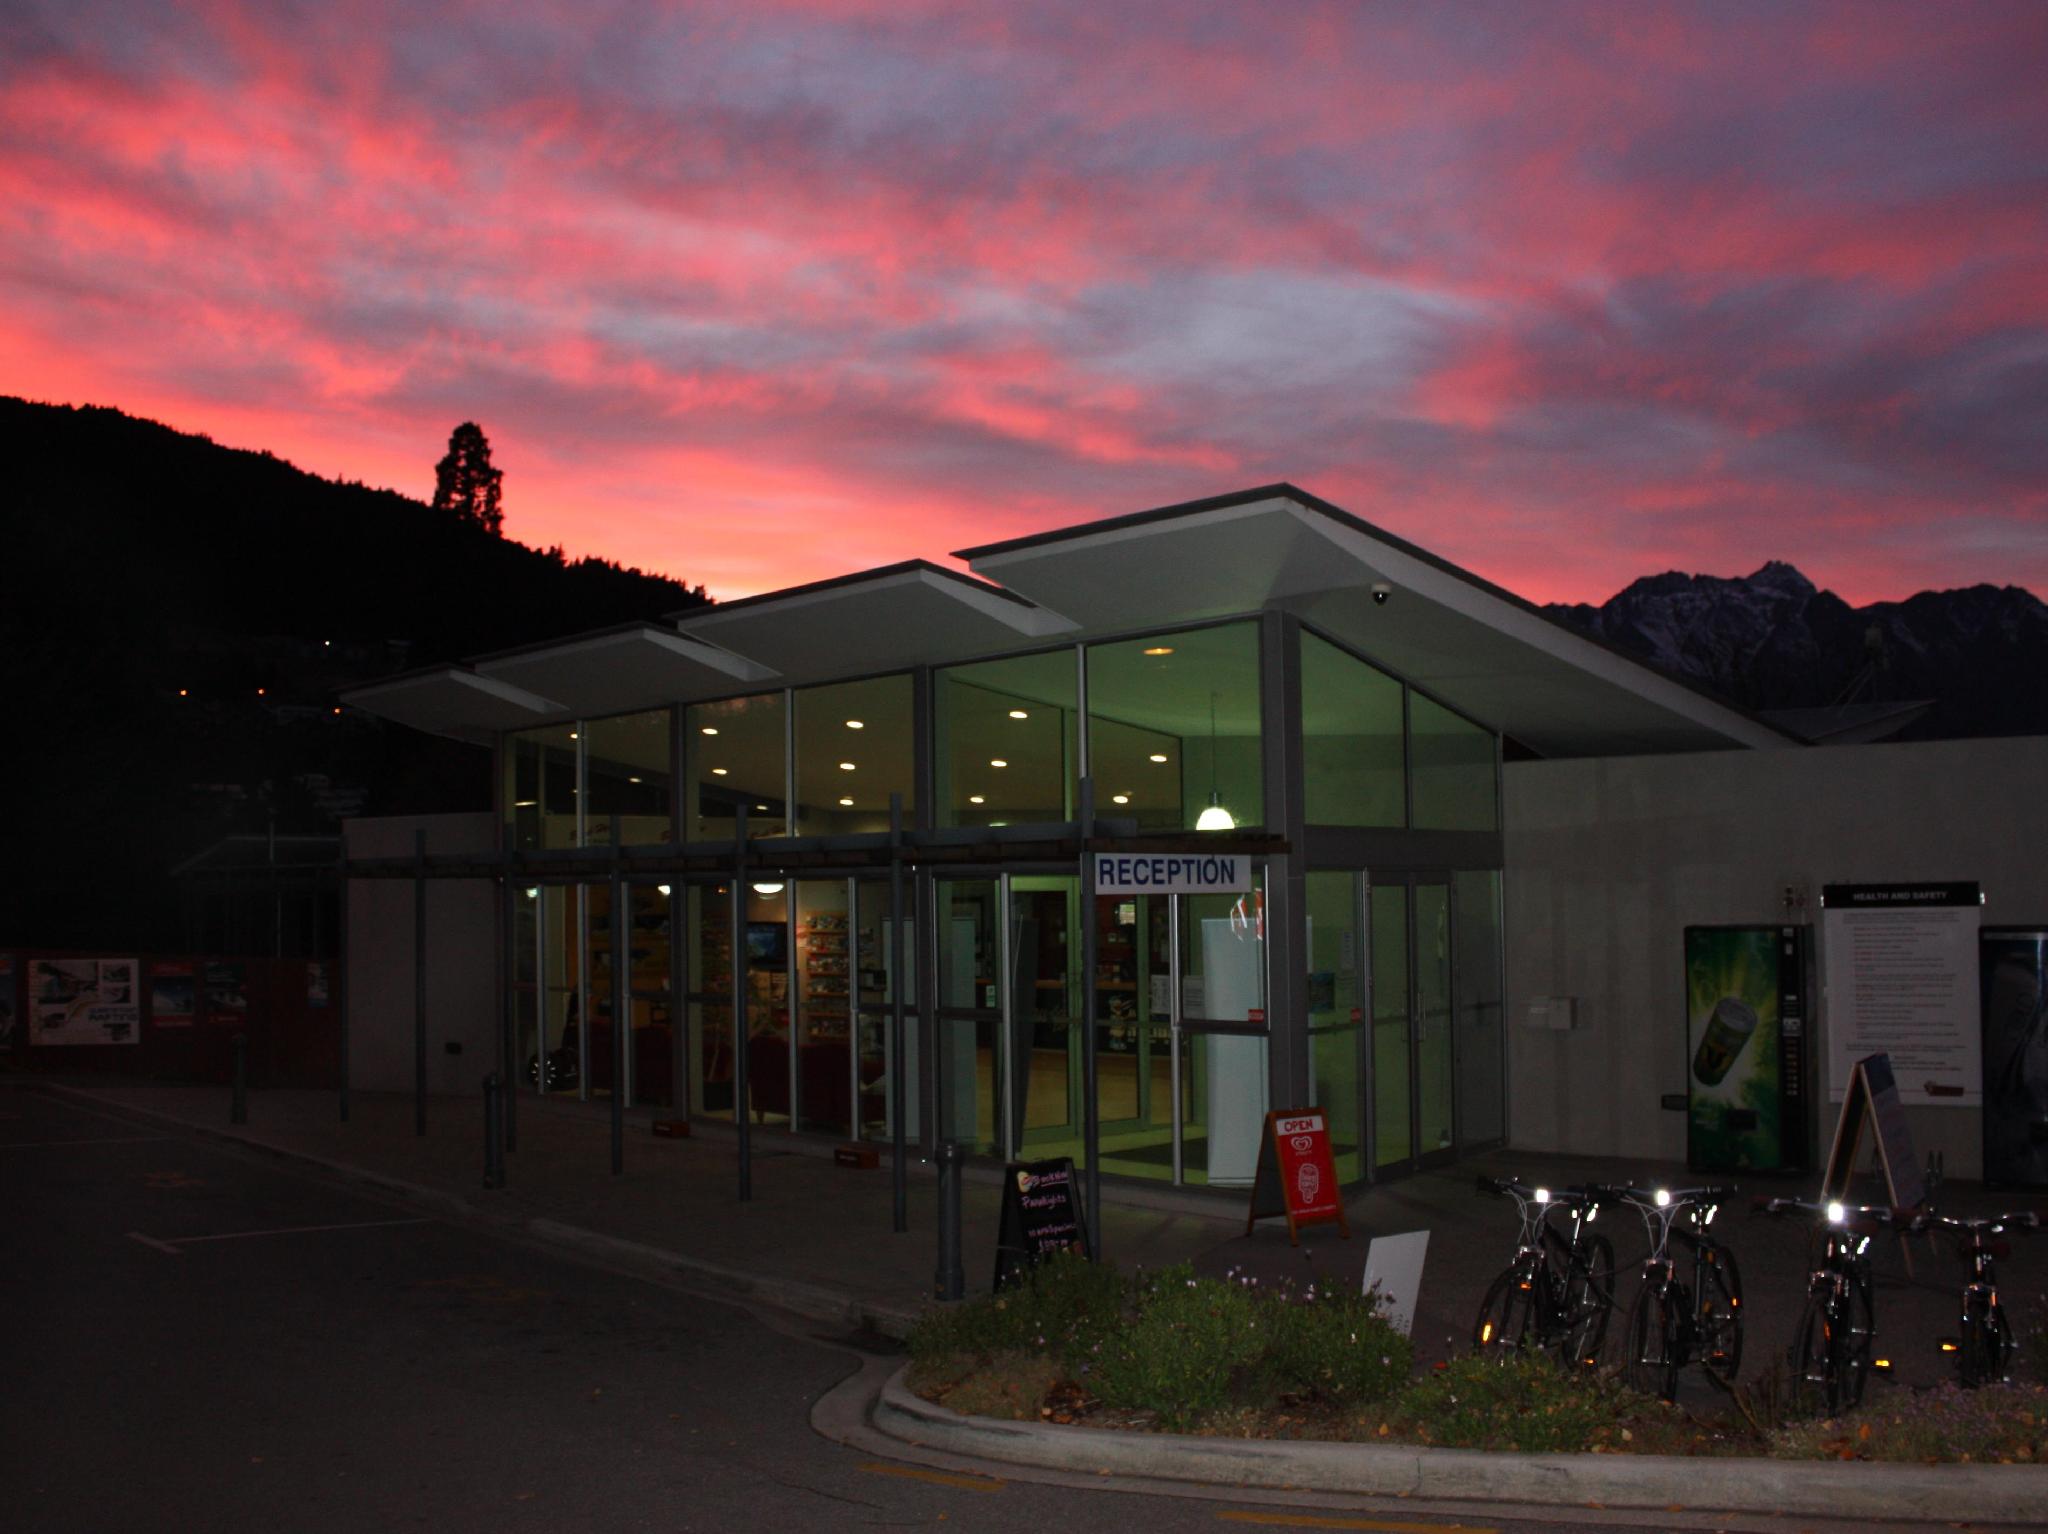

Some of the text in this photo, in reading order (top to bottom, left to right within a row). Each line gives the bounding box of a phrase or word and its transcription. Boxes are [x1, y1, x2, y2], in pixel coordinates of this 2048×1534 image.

[1099, 858, 1235, 885] RECEPTION
[1853, 890, 1948, 901] HEALTH AND SAFETY
[1284, 1118, 1313, 1132] OPEN
